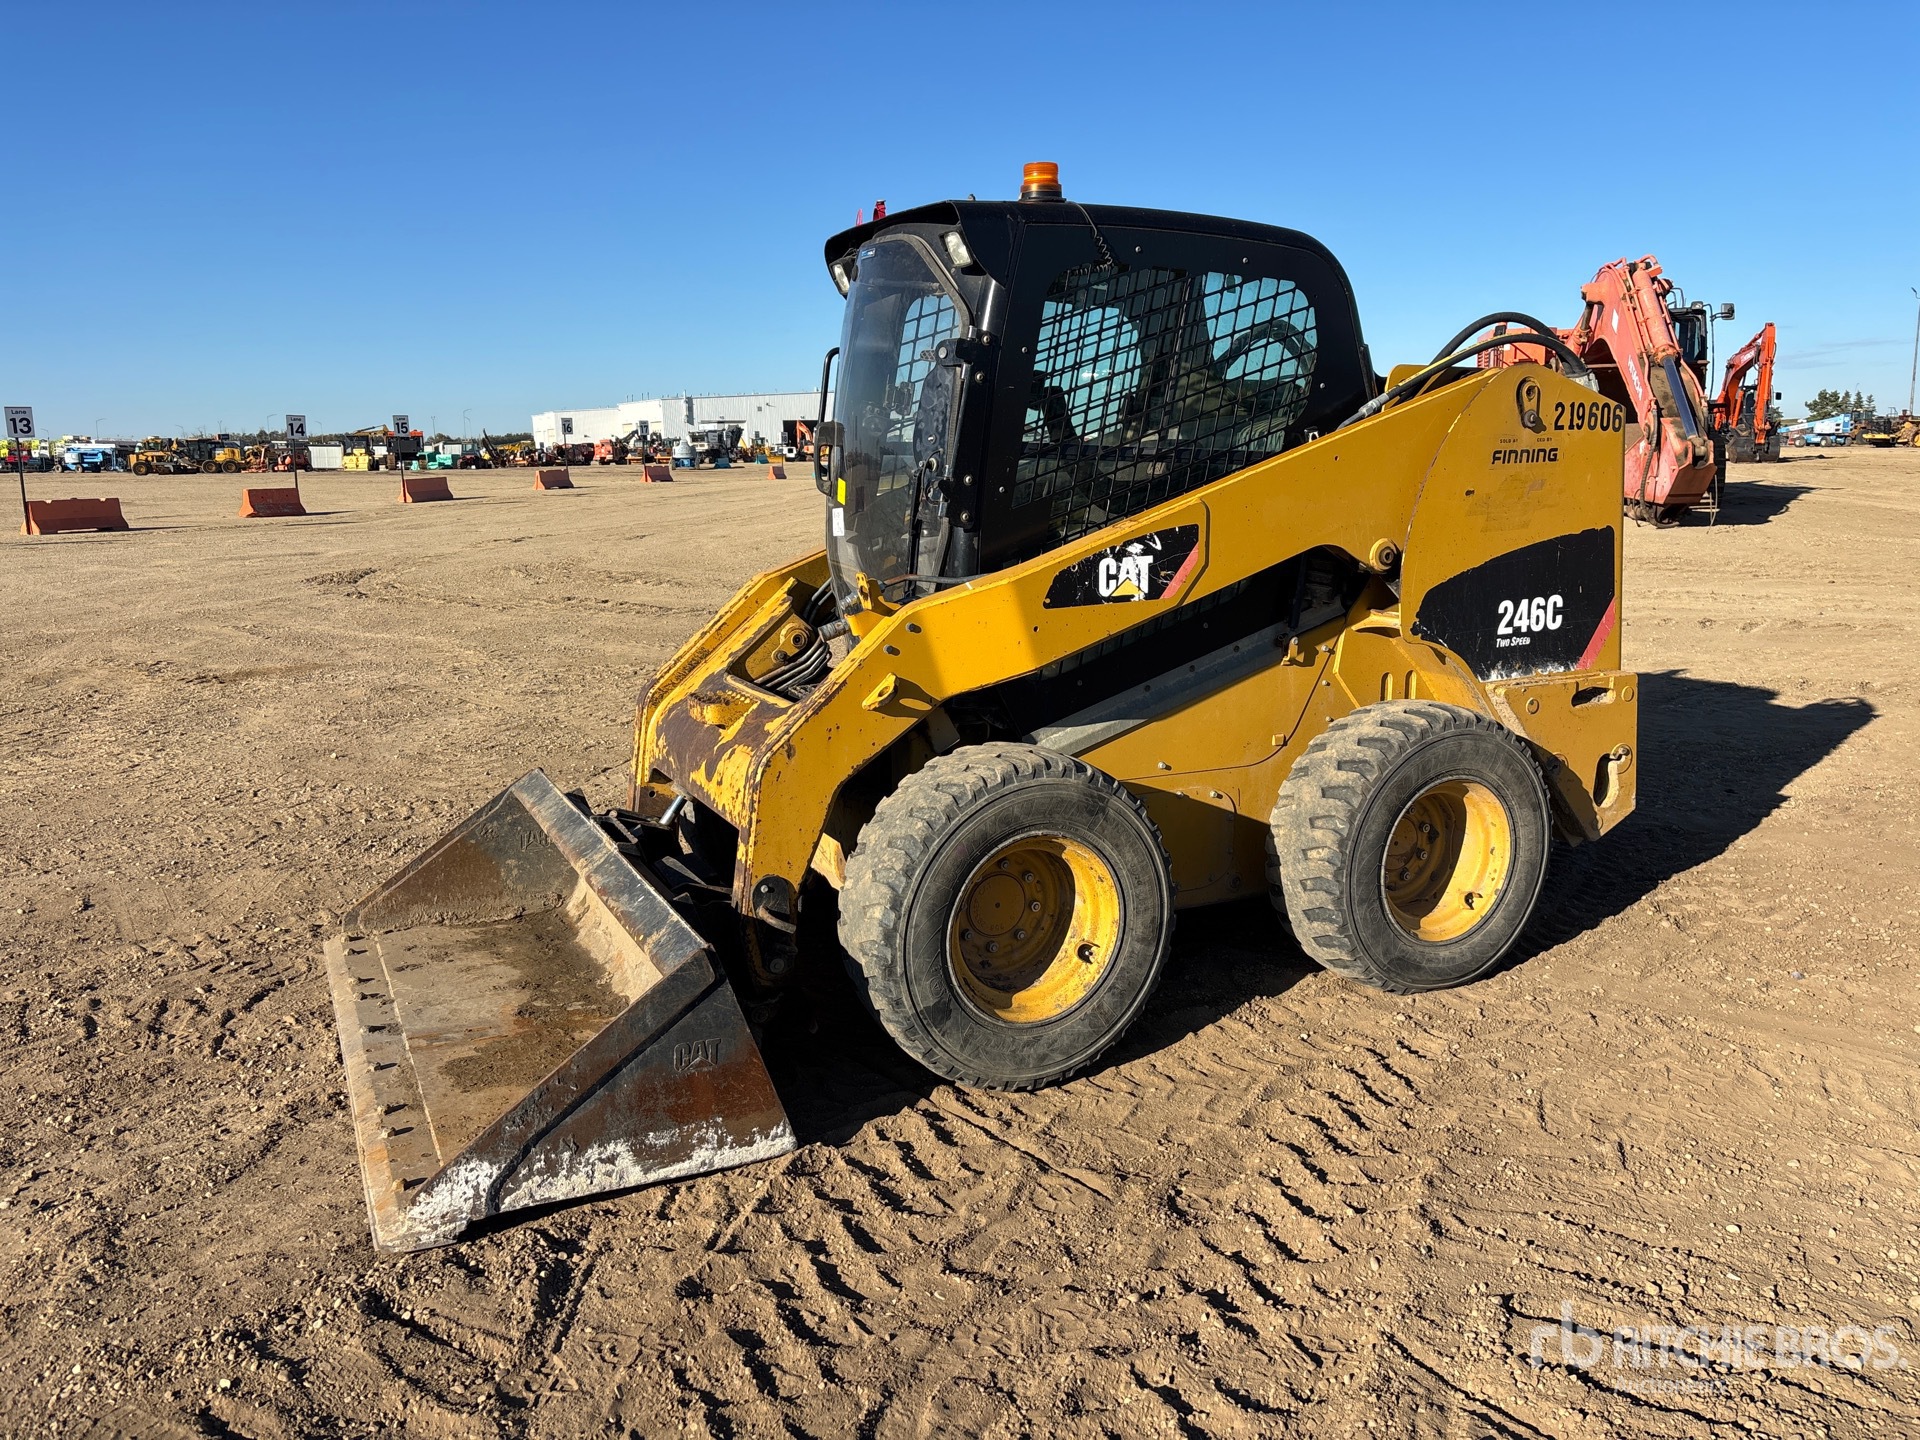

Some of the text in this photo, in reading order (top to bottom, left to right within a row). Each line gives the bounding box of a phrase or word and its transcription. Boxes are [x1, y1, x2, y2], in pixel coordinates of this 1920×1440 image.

[9, 417, 32, 434] 13
[1554, 401, 1624, 433] 219606
[288, 422, 305, 436] 14
[395, 422, 408, 434] 15
[562, 423, 572, 433] 16
[1491, 447, 1559, 465] FINNING
[1098, 555, 1153, 598] CAT
[1496, 594, 1563, 635] 246C
[673, 1037, 722, 1072] CAT
